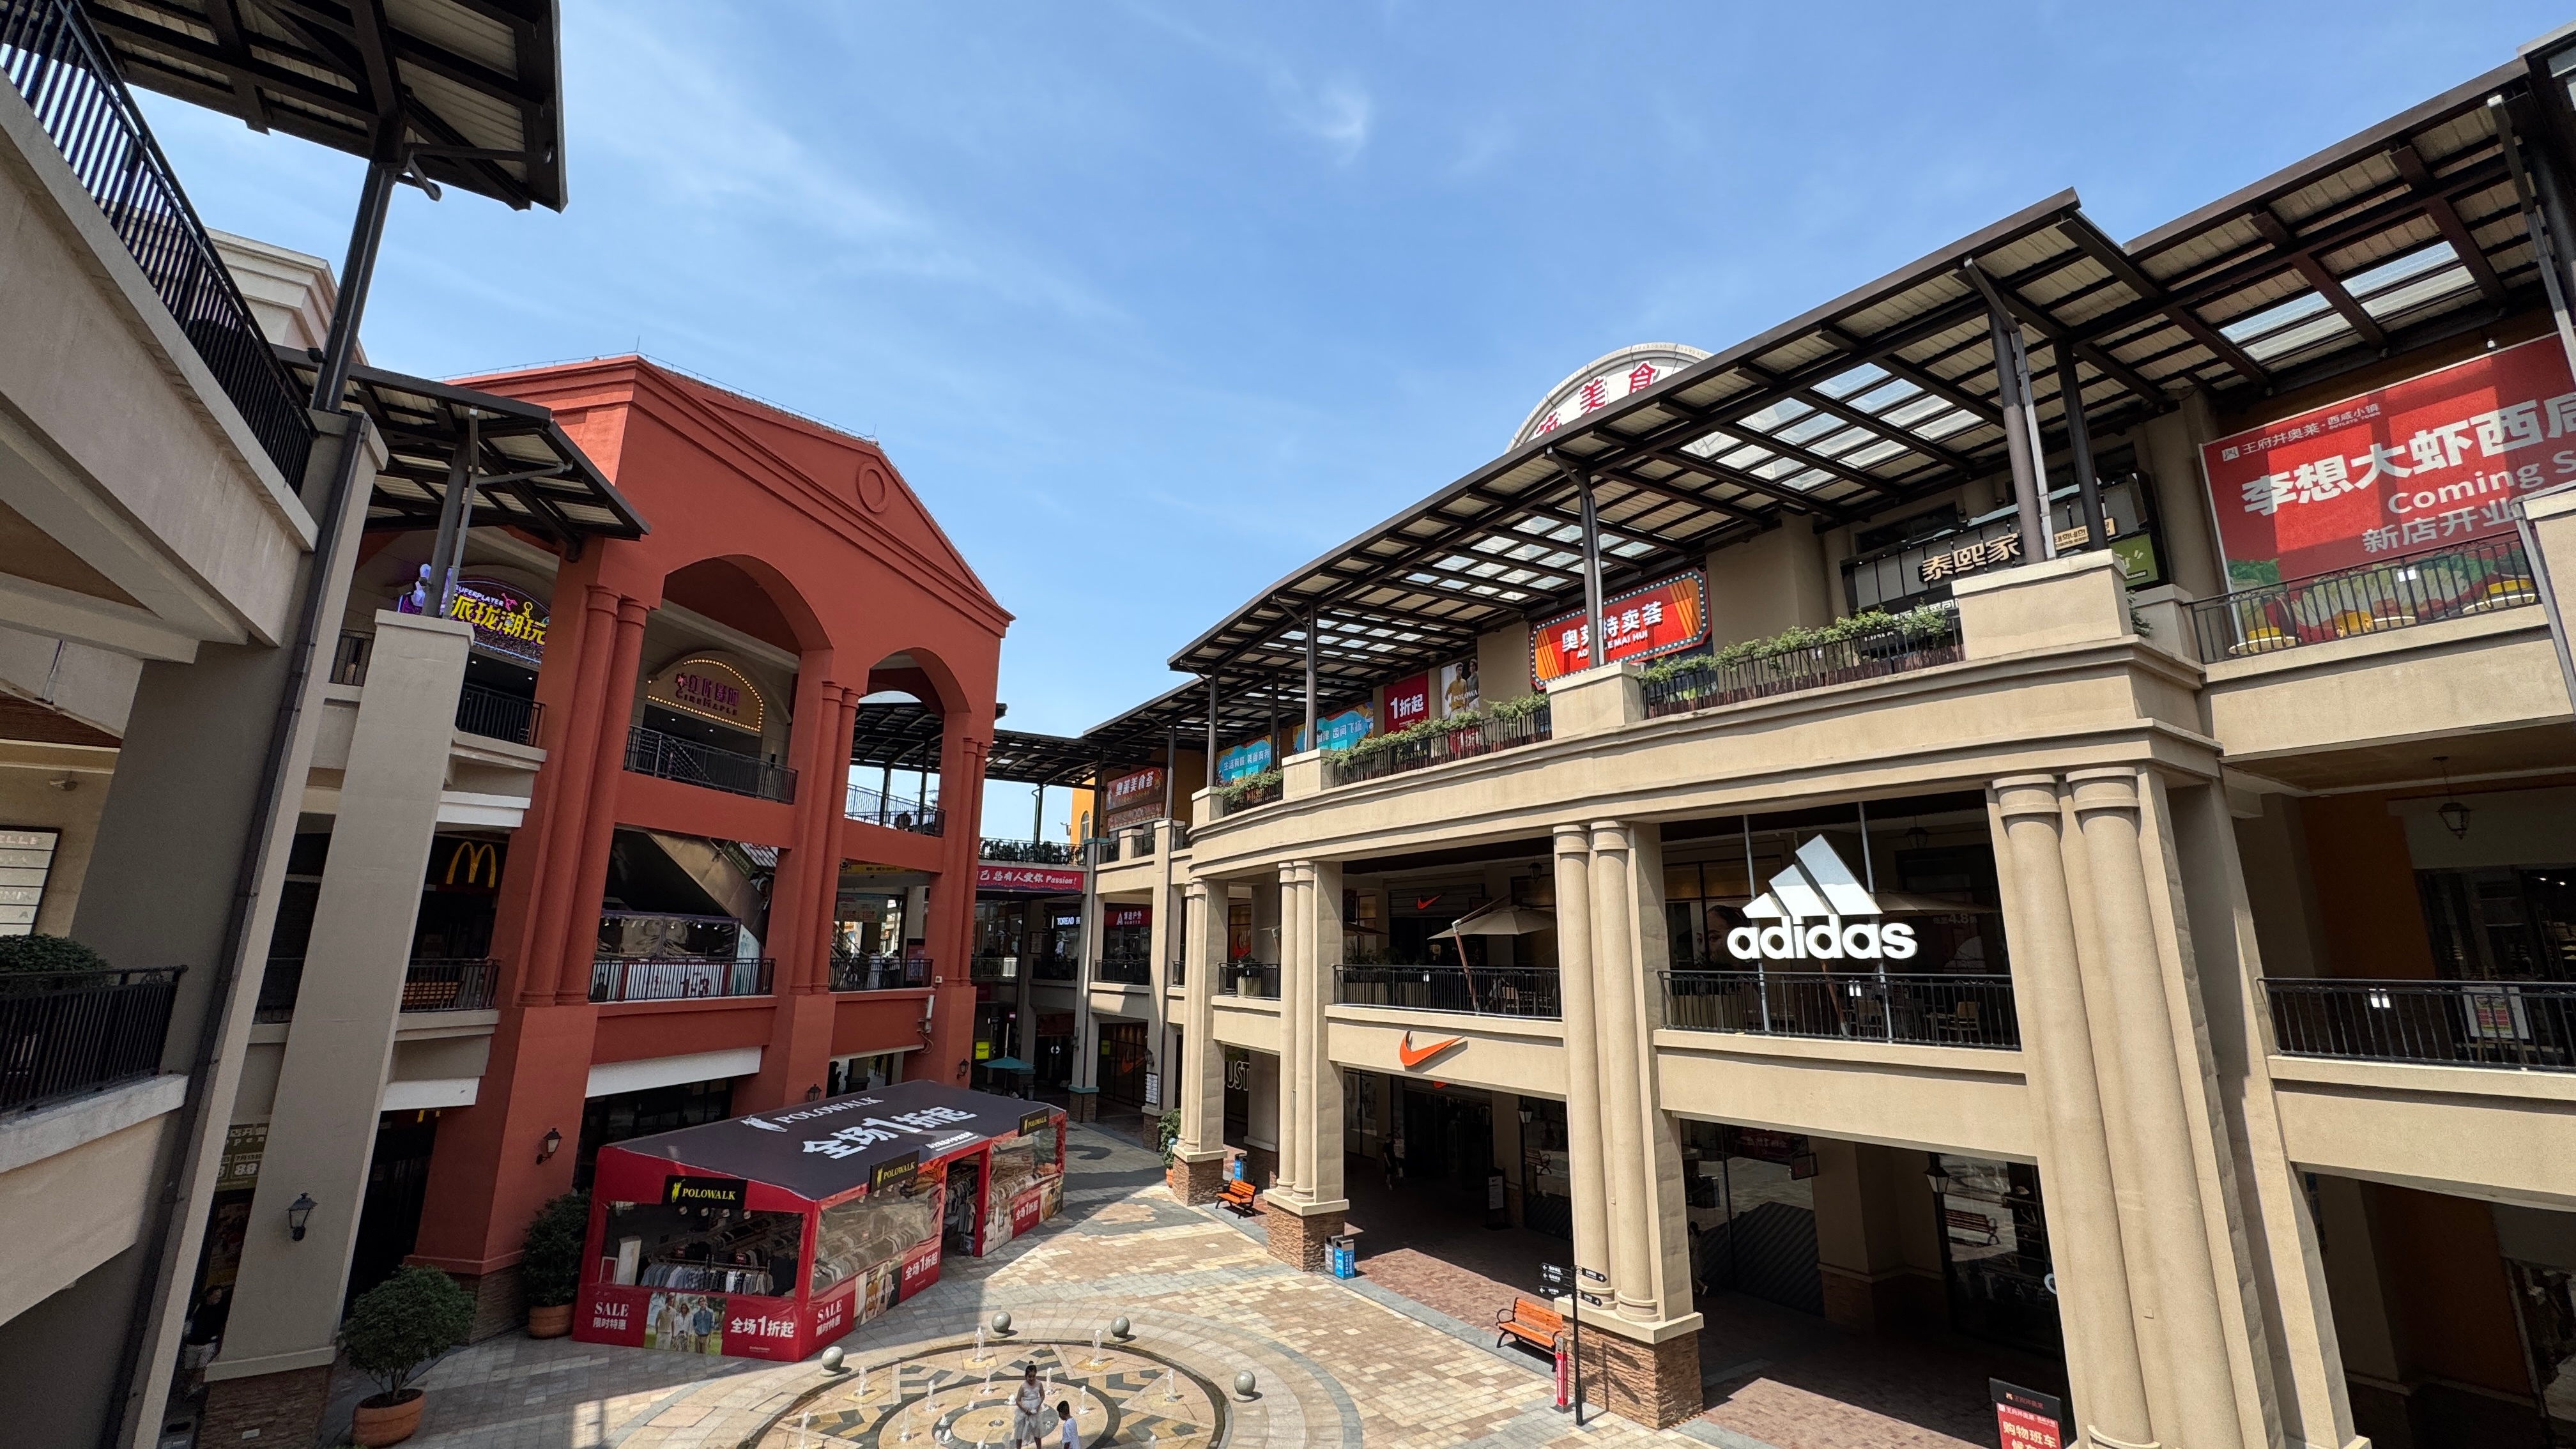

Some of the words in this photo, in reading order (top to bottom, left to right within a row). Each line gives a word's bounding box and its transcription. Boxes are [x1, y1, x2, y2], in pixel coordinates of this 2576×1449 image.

[2388, 463, 2545, 514] Coming
[1922, 532, 2021, 583] 泰熙家
[1390, 693, 1424, 719] 1折起
[1453, 689, 1479, 702] POLOWA
[1726, 915, 1918, 960] adidas
[773, 1096, 885, 1125] POLOWALK
[802, 1105, 977, 1160] 全场1折起
[882, 1162, 916, 1180] POLOWALK
[682, 1188, 737, 1201] POLOWALK
[905, 1251, 939, 1281] 全场1折起
[594, 1301, 629, 1317] SALE
[816, 1298, 843, 1324] SALE
[592, 1317, 627, 1331] 限时特惠
[730, 1314, 795, 1338] 全场1折起
[2002, 1421, 2057, 1449] 购物班车
